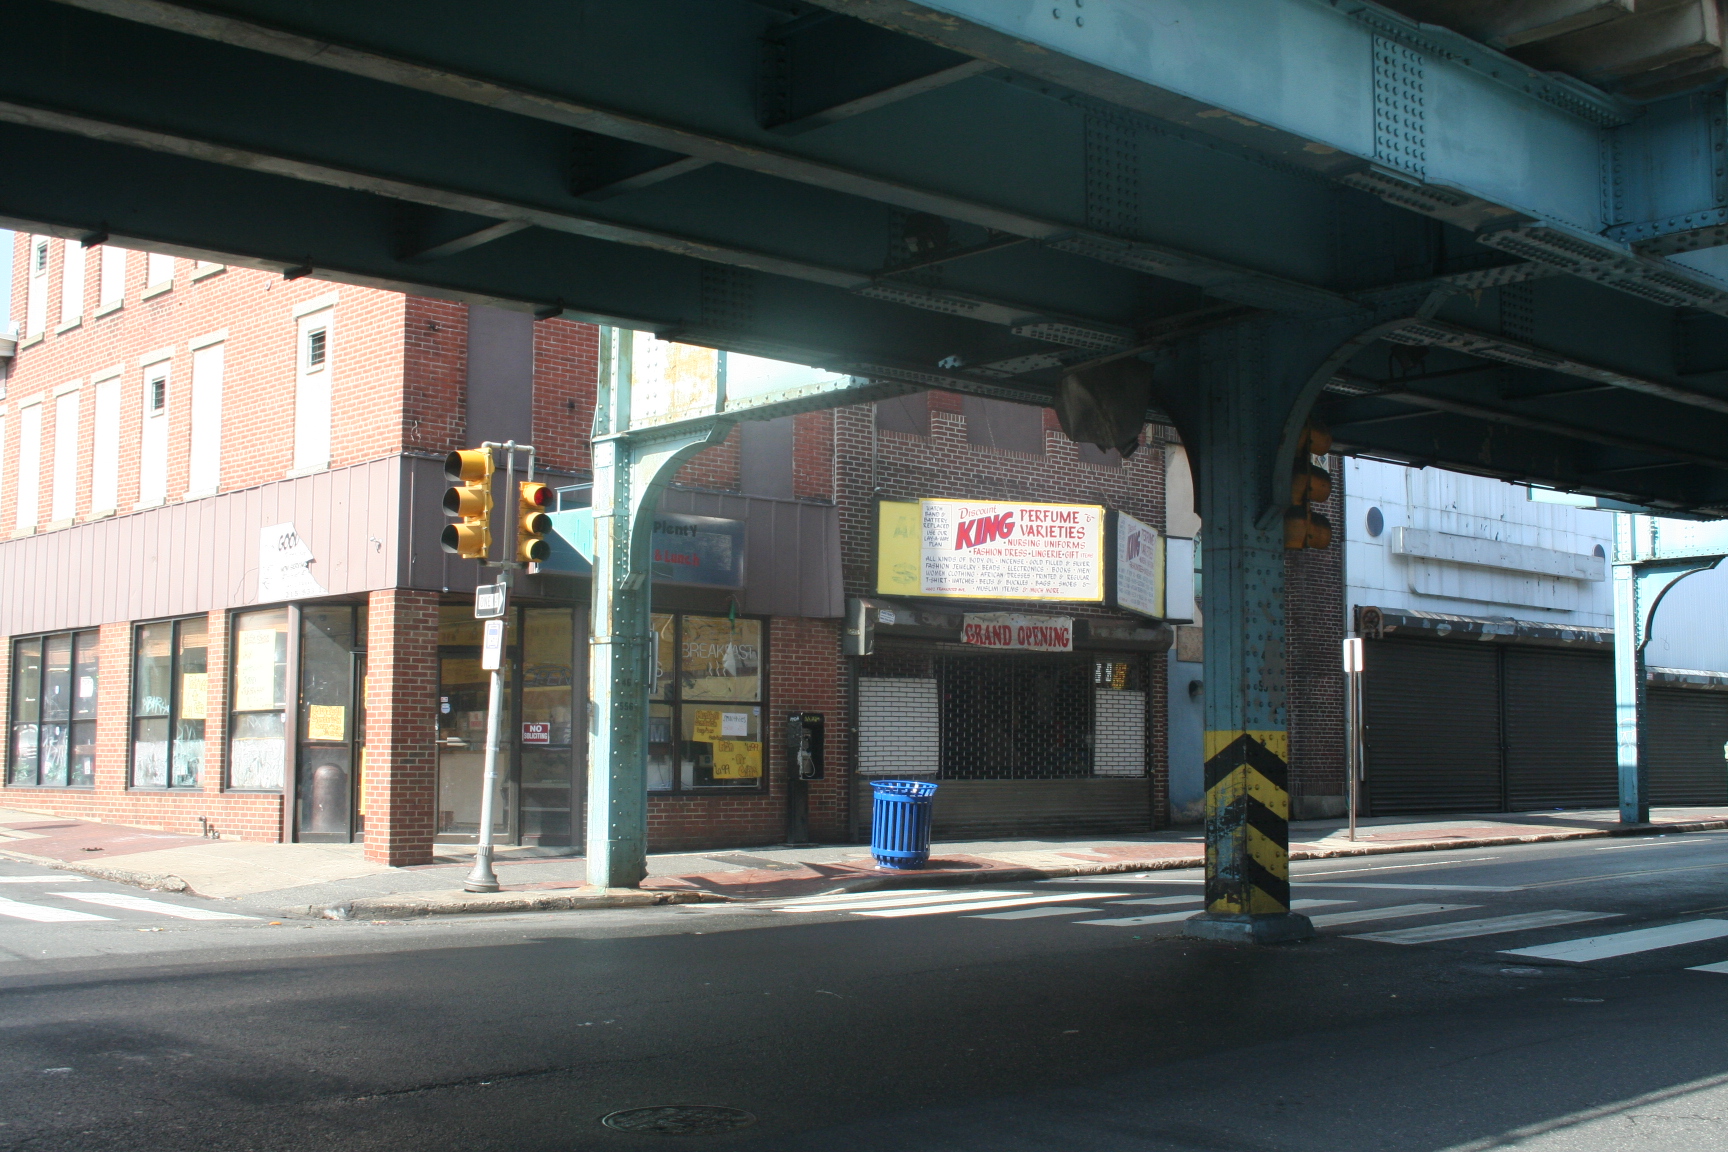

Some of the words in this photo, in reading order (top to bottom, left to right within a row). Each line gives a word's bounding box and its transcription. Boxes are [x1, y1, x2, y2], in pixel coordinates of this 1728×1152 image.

[958, 505, 997, 520] Discount
[1020, 509, 1080, 524] PERFUME
[955, 511, 1015, 551] KING
[1020, 524, 1086, 540] VARIETIES
[1008, 539, 1040, 548] NURSING
[1044, 540, 1086, 550] UNIFORMS
[654, 548, 662, 561] &
[664, 549, 700, 567] Lunch
[973, 548, 1002, 556] FASHION
[1005, 548, 1028, 557] DRESS
[1031, 549, 1062, 558] LINGERIE
[1065, 550, 1079, 559] GIFT
[965, 623, 1012, 646] GRAND
[1018, 625, 1070, 648] OPENING
[682, 642, 753, 660] BREAKAST
[523, 732, 548, 740] SOLICITING
